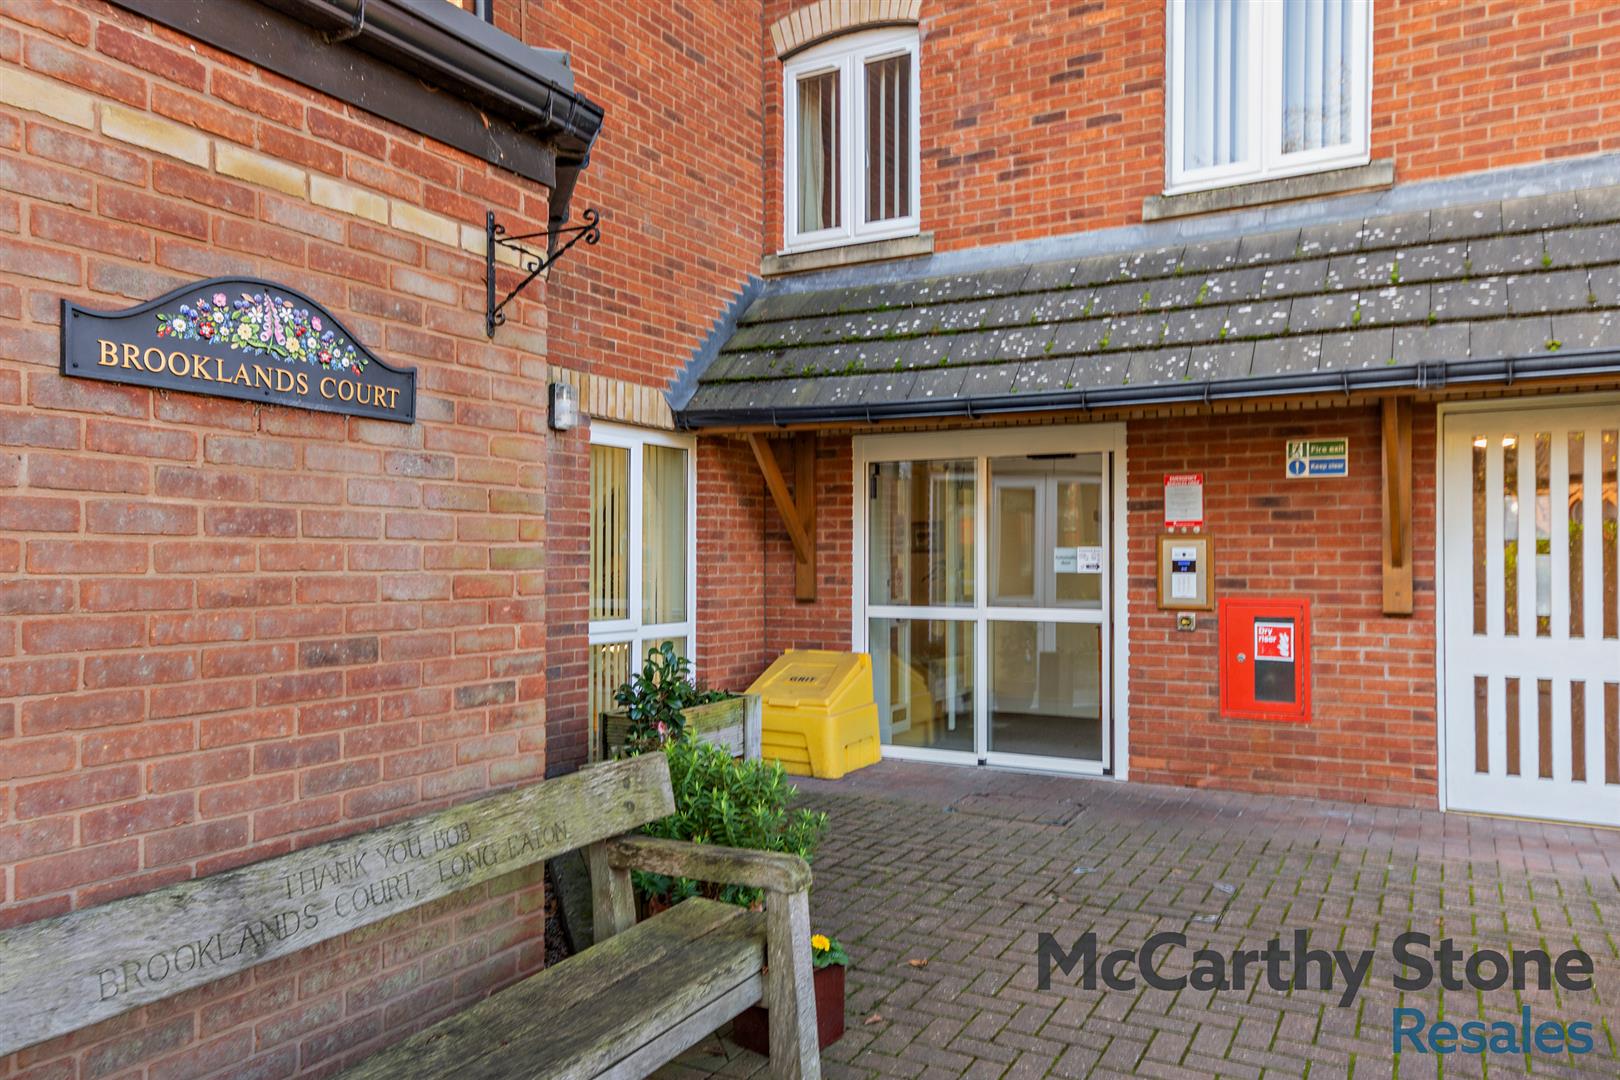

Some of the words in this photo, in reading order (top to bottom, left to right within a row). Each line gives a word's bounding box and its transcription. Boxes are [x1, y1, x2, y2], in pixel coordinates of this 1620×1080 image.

[97, 339, 309, 395] BROOKLANDS
[319, 376, 400, 409] COURT
[1258, 627, 1272, 636] Dry
[281, 851, 367, 900] THANK
[376, 836, 424, 869] YOU
[433, 822, 472, 852] BOB
[97, 903, 319, 1001] BROOKLANDS
[334, 869, 420, 918] COURT,
[438, 848, 498, 884] LONG
